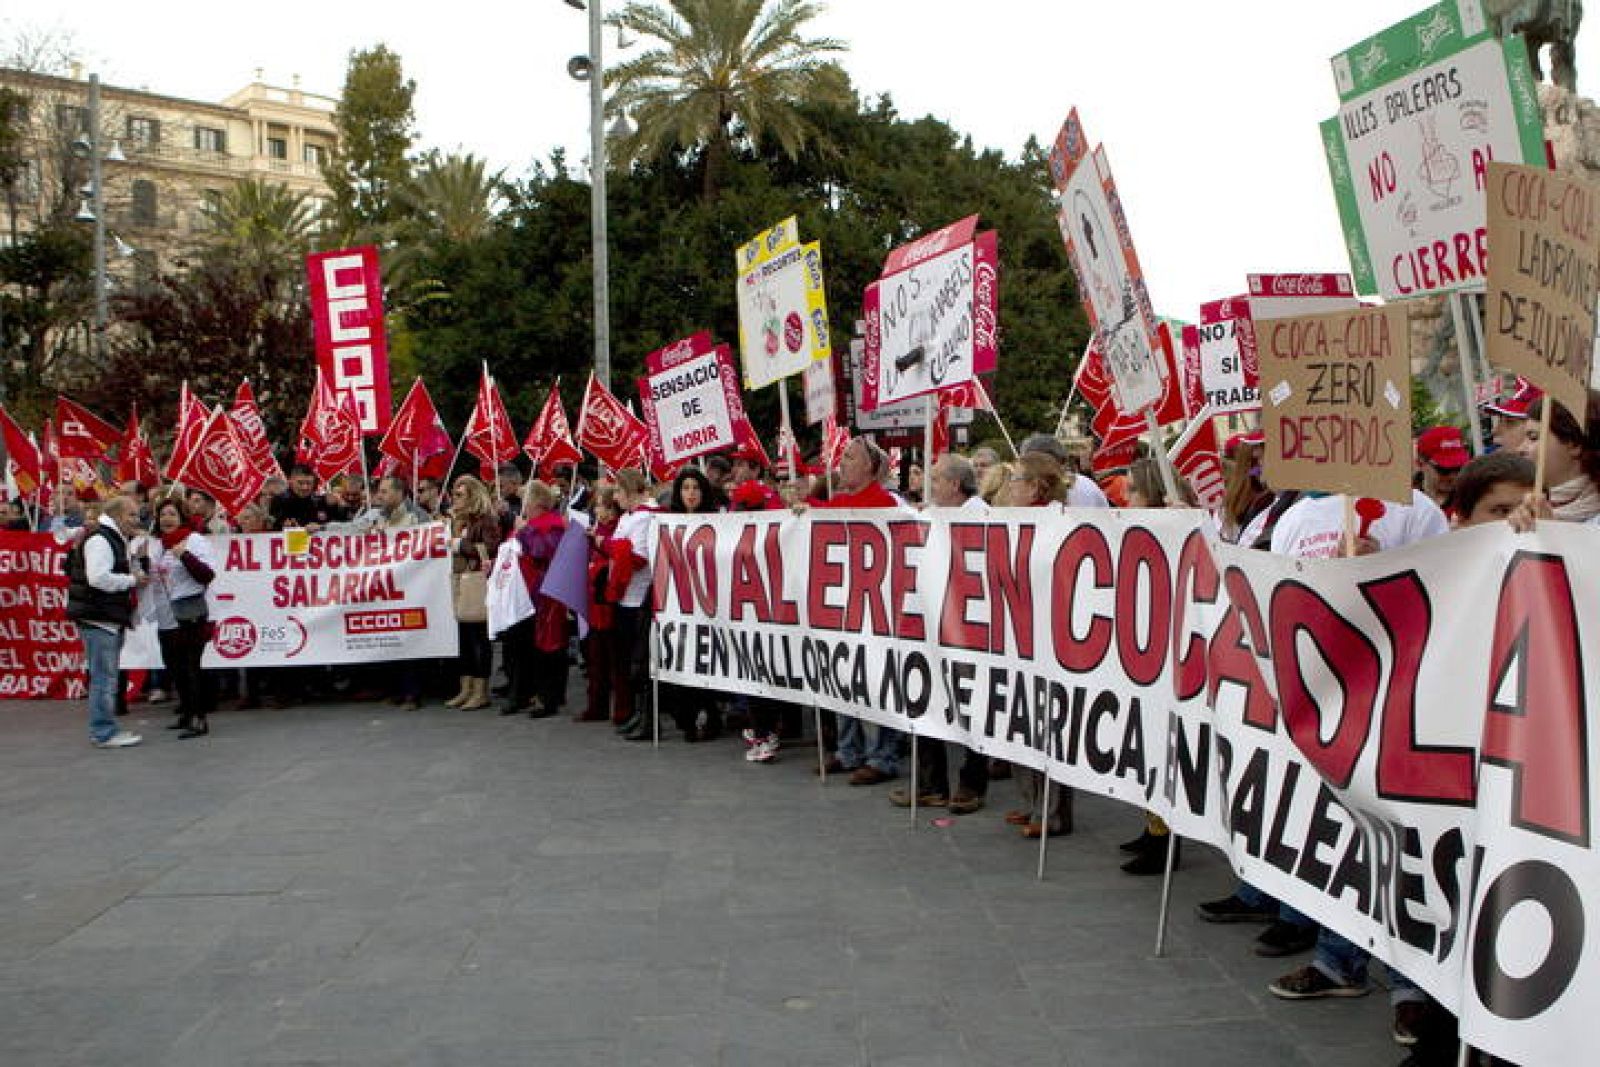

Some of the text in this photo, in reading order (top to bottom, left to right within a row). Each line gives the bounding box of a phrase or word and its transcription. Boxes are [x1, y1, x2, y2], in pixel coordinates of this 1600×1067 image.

[1385, 67, 1463, 124] BALEARS
[1367, 150, 1397, 203] NO
[1270, 312, 1392, 361] COCA-COLA
[681, 397, 703, 419] DE
[1205, 386, 1261, 406] TRAB
[1304, 360, 1377, 408] ZERO
[1279, 412, 1395, 467] DESPIDOS
[225, 537, 261, 572] AL
[272, 567, 406, 608] SALARIAL
[653, 524, 719, 619] NO
[730, 522, 799, 625] AL
[808, 520, 930, 641] ERE
[940, 522, 1035, 661] EN
[694, 624, 729, 677] EN
[730, 629, 872, 709] MALLORCA
[879, 647, 932, 719] NO
